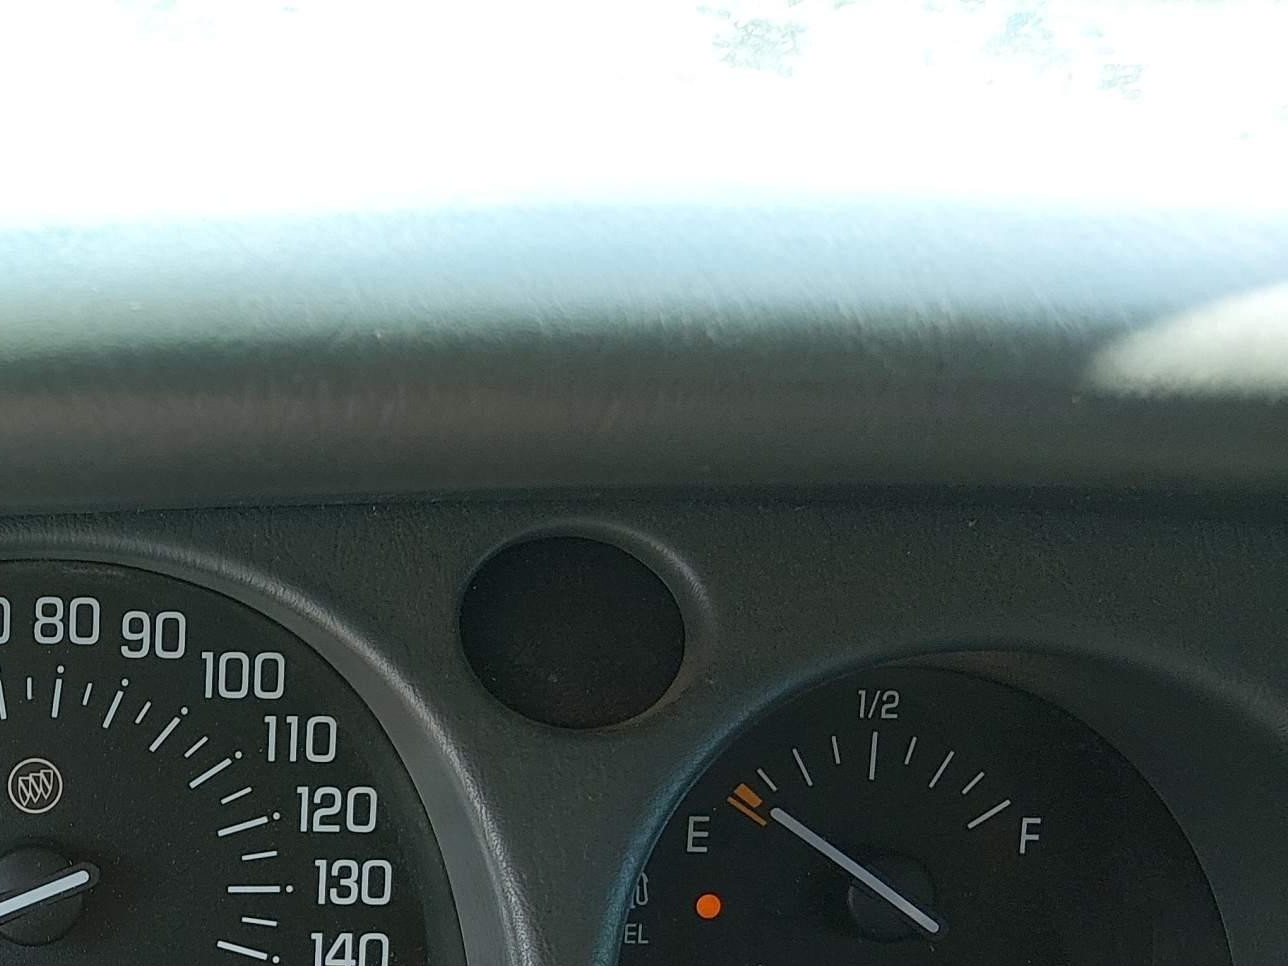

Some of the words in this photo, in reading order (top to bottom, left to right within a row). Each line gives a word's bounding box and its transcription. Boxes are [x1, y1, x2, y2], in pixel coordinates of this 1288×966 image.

[33, 596, 101, 645] 80
[120, 610, 186, 659] 90
[201, 651, 285, 700] 100
[856, 690, 900, 719] 1/2
[264, 715, 337, 762] 110
[296, 786, 377, 833] 120
[687, 816, 709, 853] E
[1019, 818, 1041, 854] F
[314, 860, 392, 905] 130
[624, 923, 649, 944] EL
